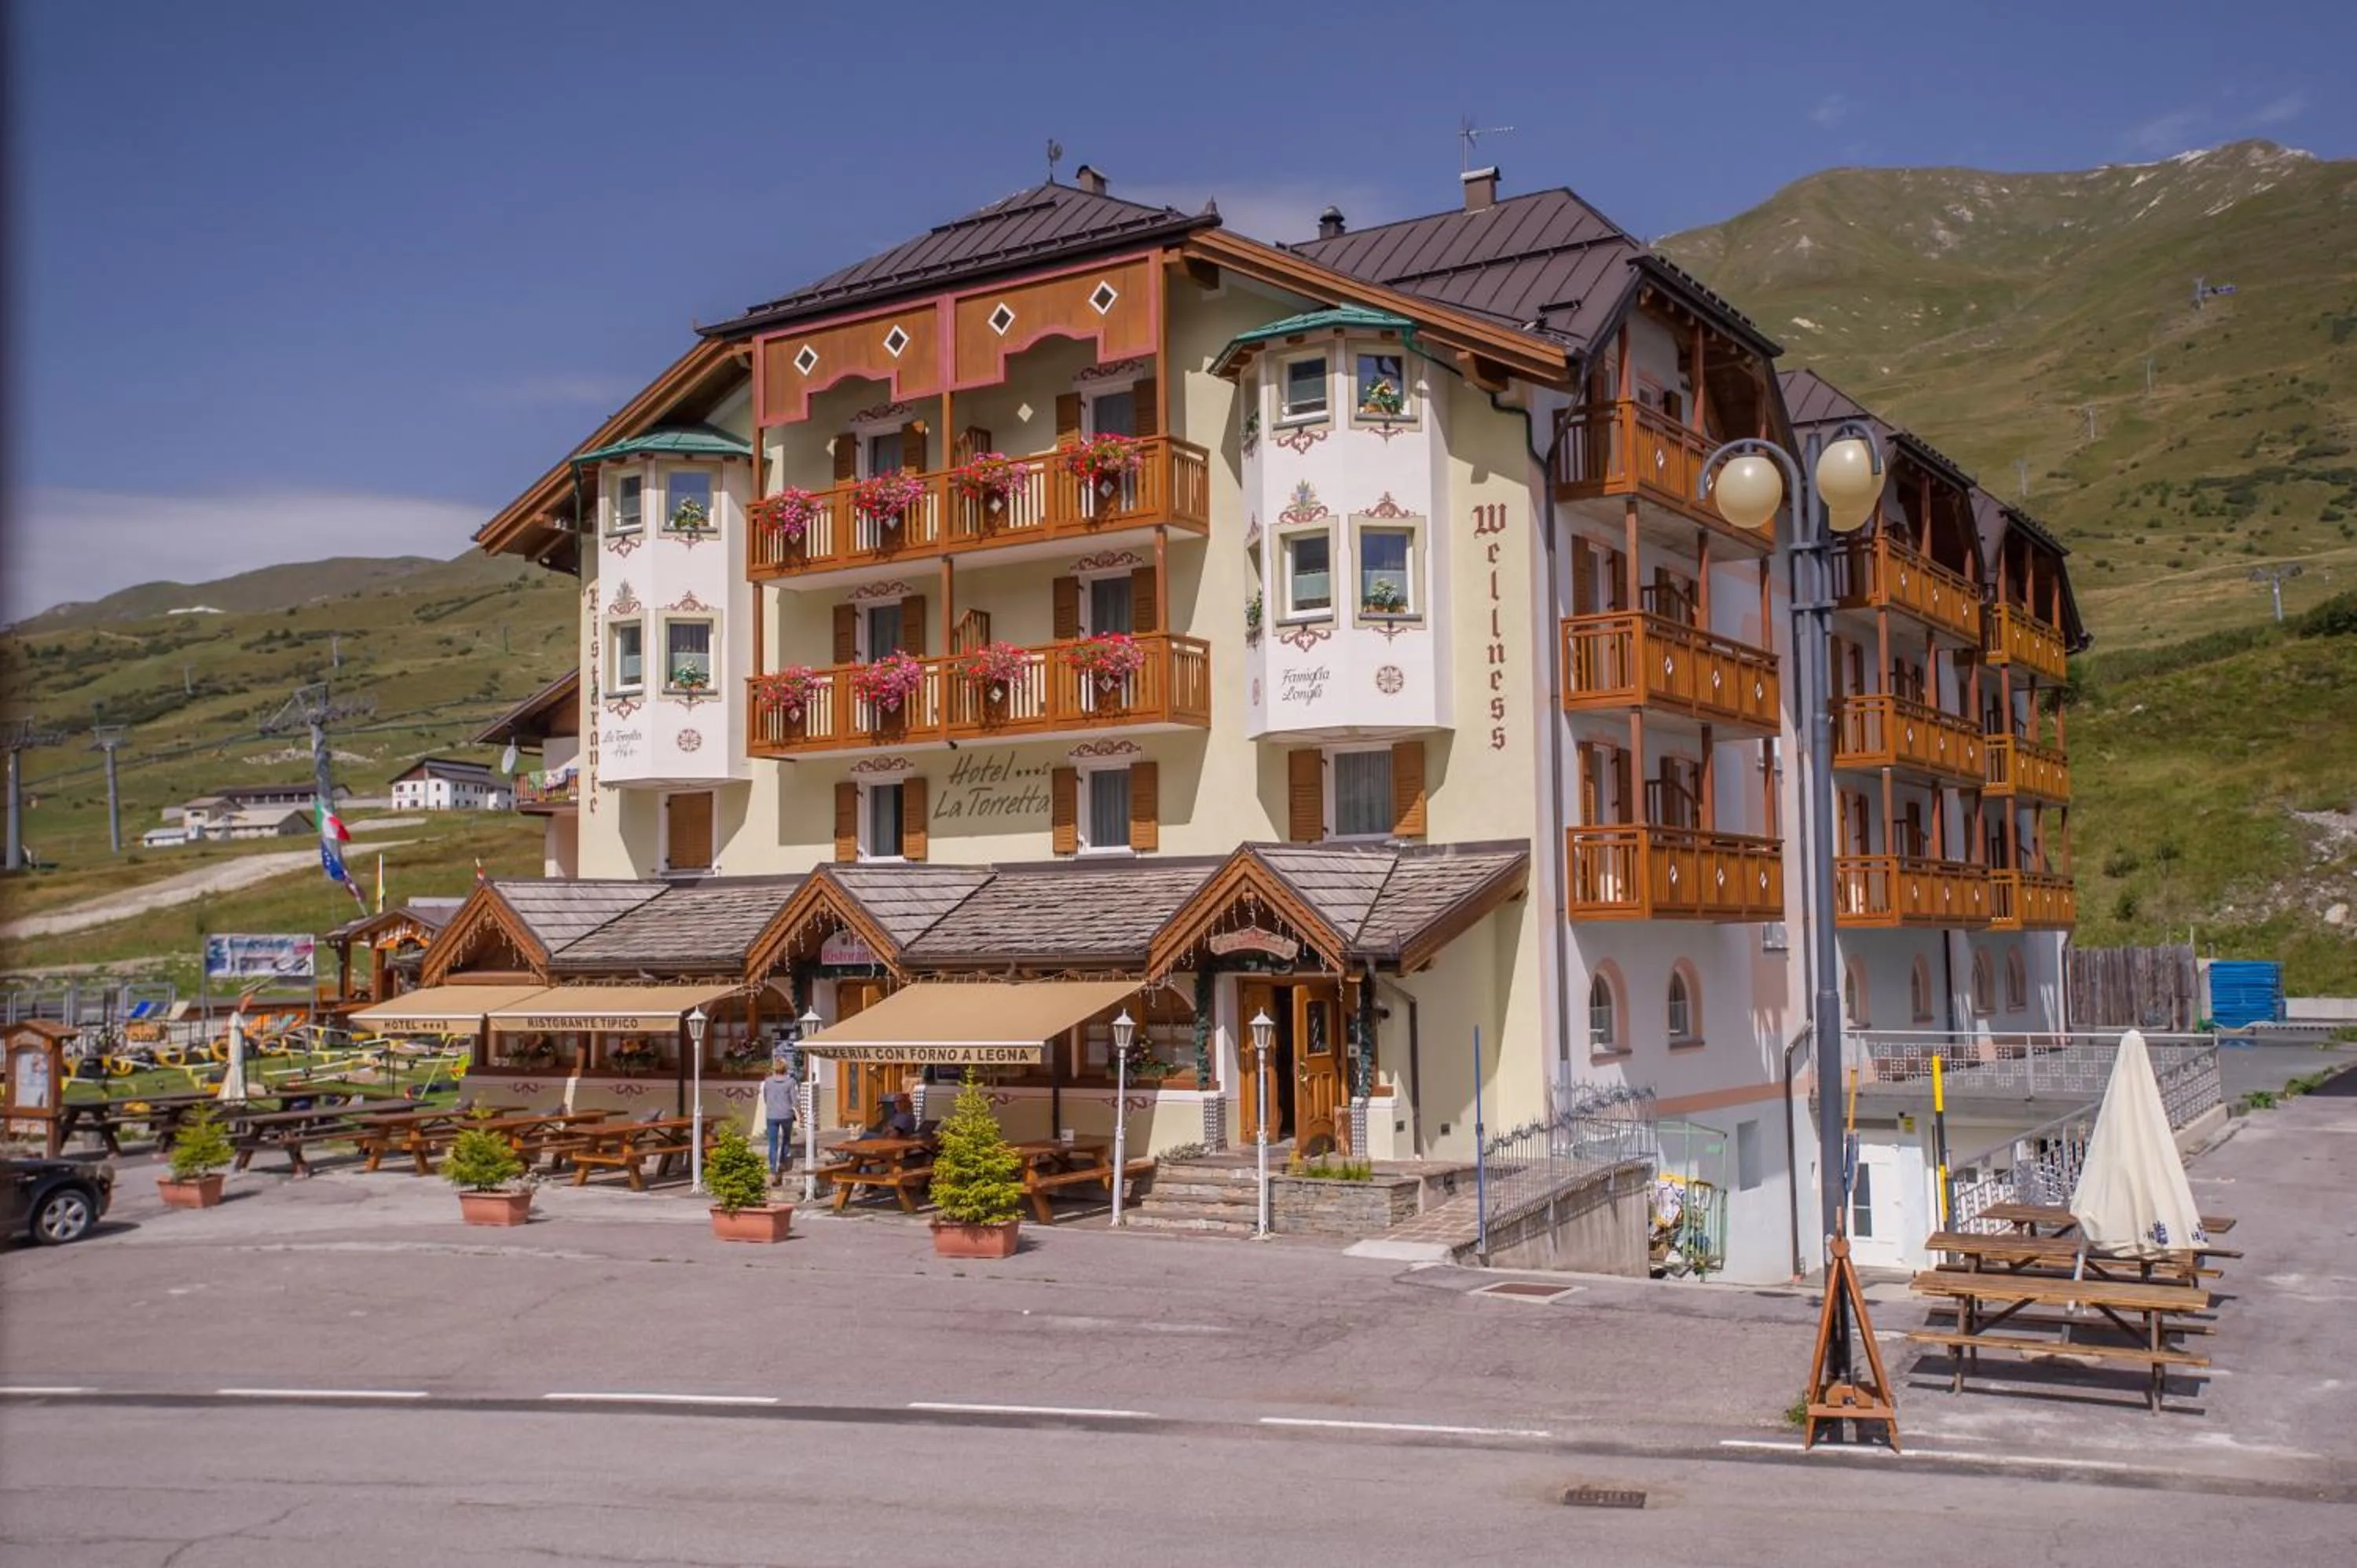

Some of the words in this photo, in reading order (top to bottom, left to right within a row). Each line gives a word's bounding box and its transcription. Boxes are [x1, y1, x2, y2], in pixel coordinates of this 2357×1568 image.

[1471, 502, 1507, 751] Wellness
[948, 750, 1016, 786] Hotel
[933, 790, 962, 819] La
[967, 784, 1050, 817] Torretta
[383, 1019, 418, 1030] HOTEL
[527, 1017, 597, 1029] RISTORANTE
[602, 1017, 639, 1029] TIPICO
[876, 1049, 905, 1060] CON
[910, 1049, 958, 1061] FORNO
[961, 1049, 972, 1061] A
[977, 1049, 1029, 1061] LEGNA
